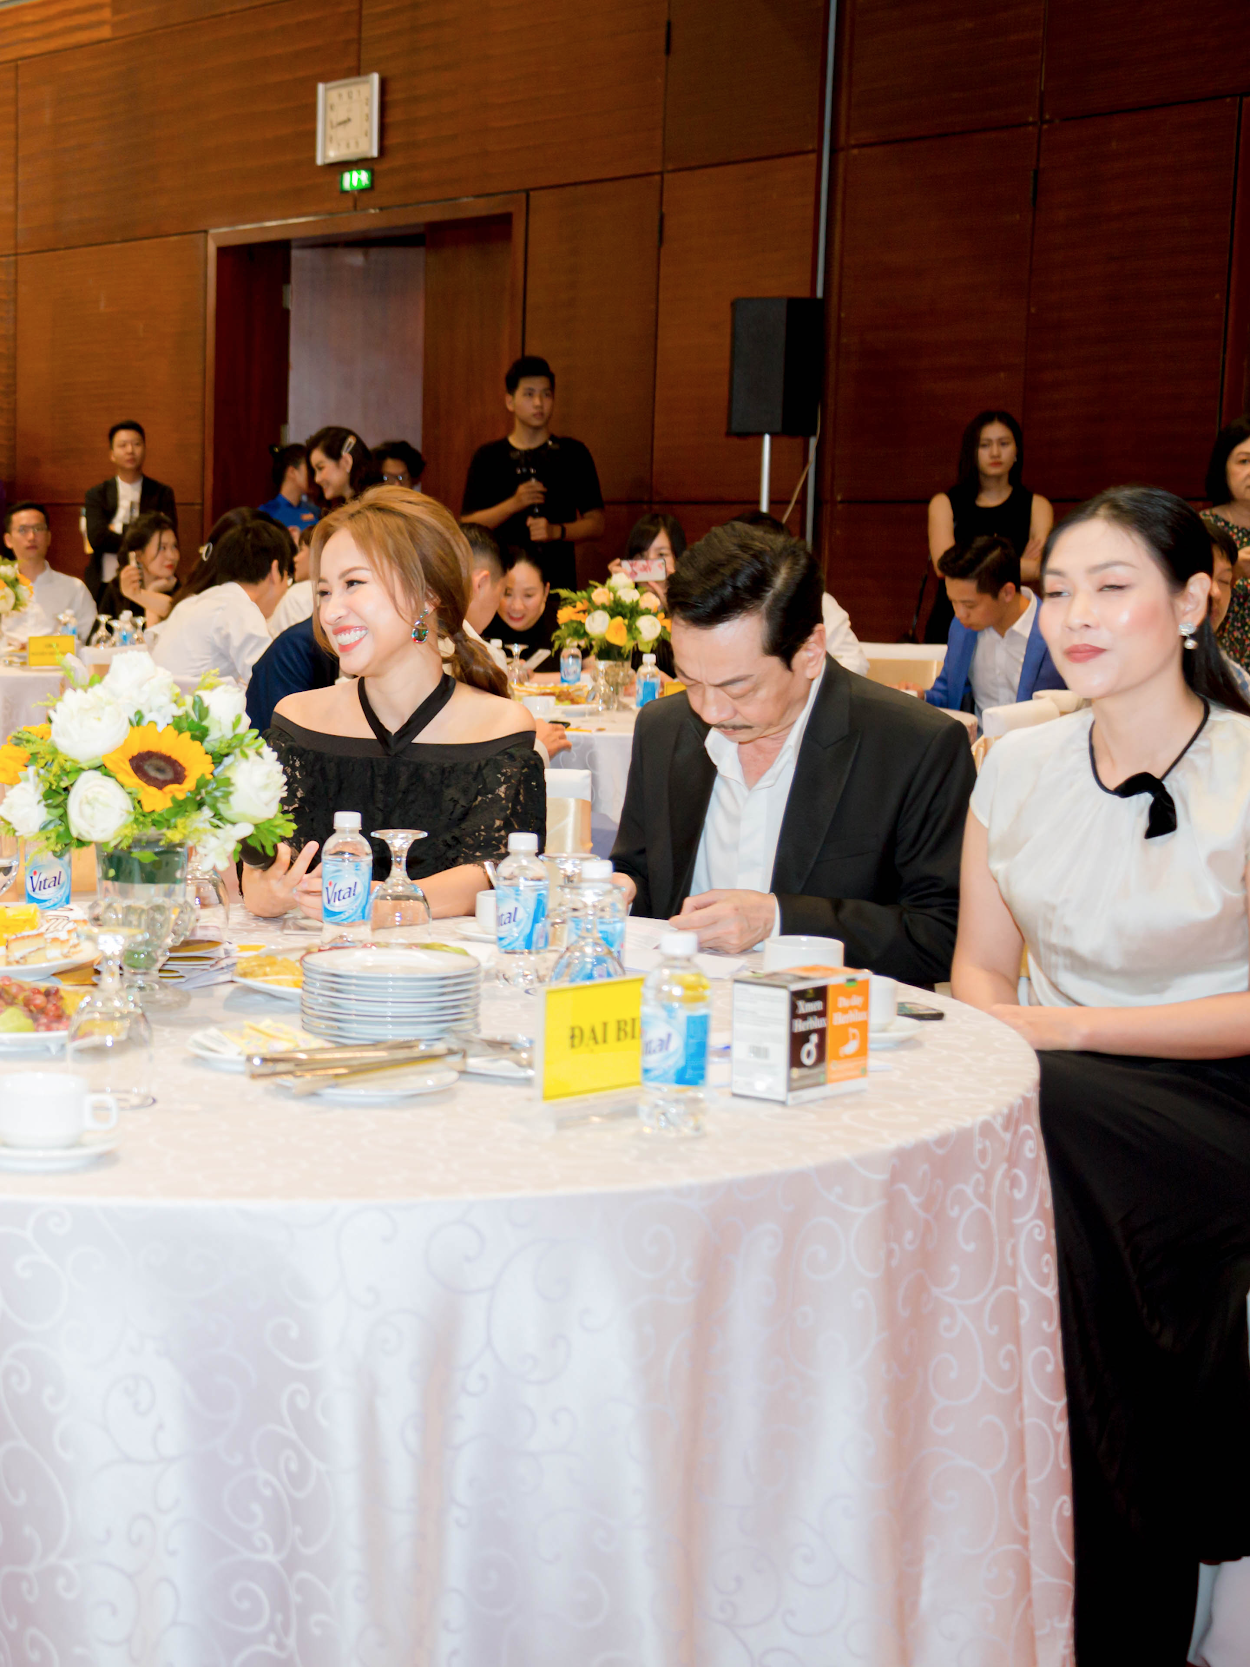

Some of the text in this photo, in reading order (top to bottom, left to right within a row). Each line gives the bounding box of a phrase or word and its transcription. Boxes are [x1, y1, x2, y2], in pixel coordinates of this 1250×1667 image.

[29, 870, 62, 893] Vital
[325, 881, 357, 904] Vital
[795, 999, 823, 1014] Xmen
[792, 1015, 827, 1033] Herblux
[832, 1009, 868, 1025] Herblux
[616, 1017, 641, 1042] BI
